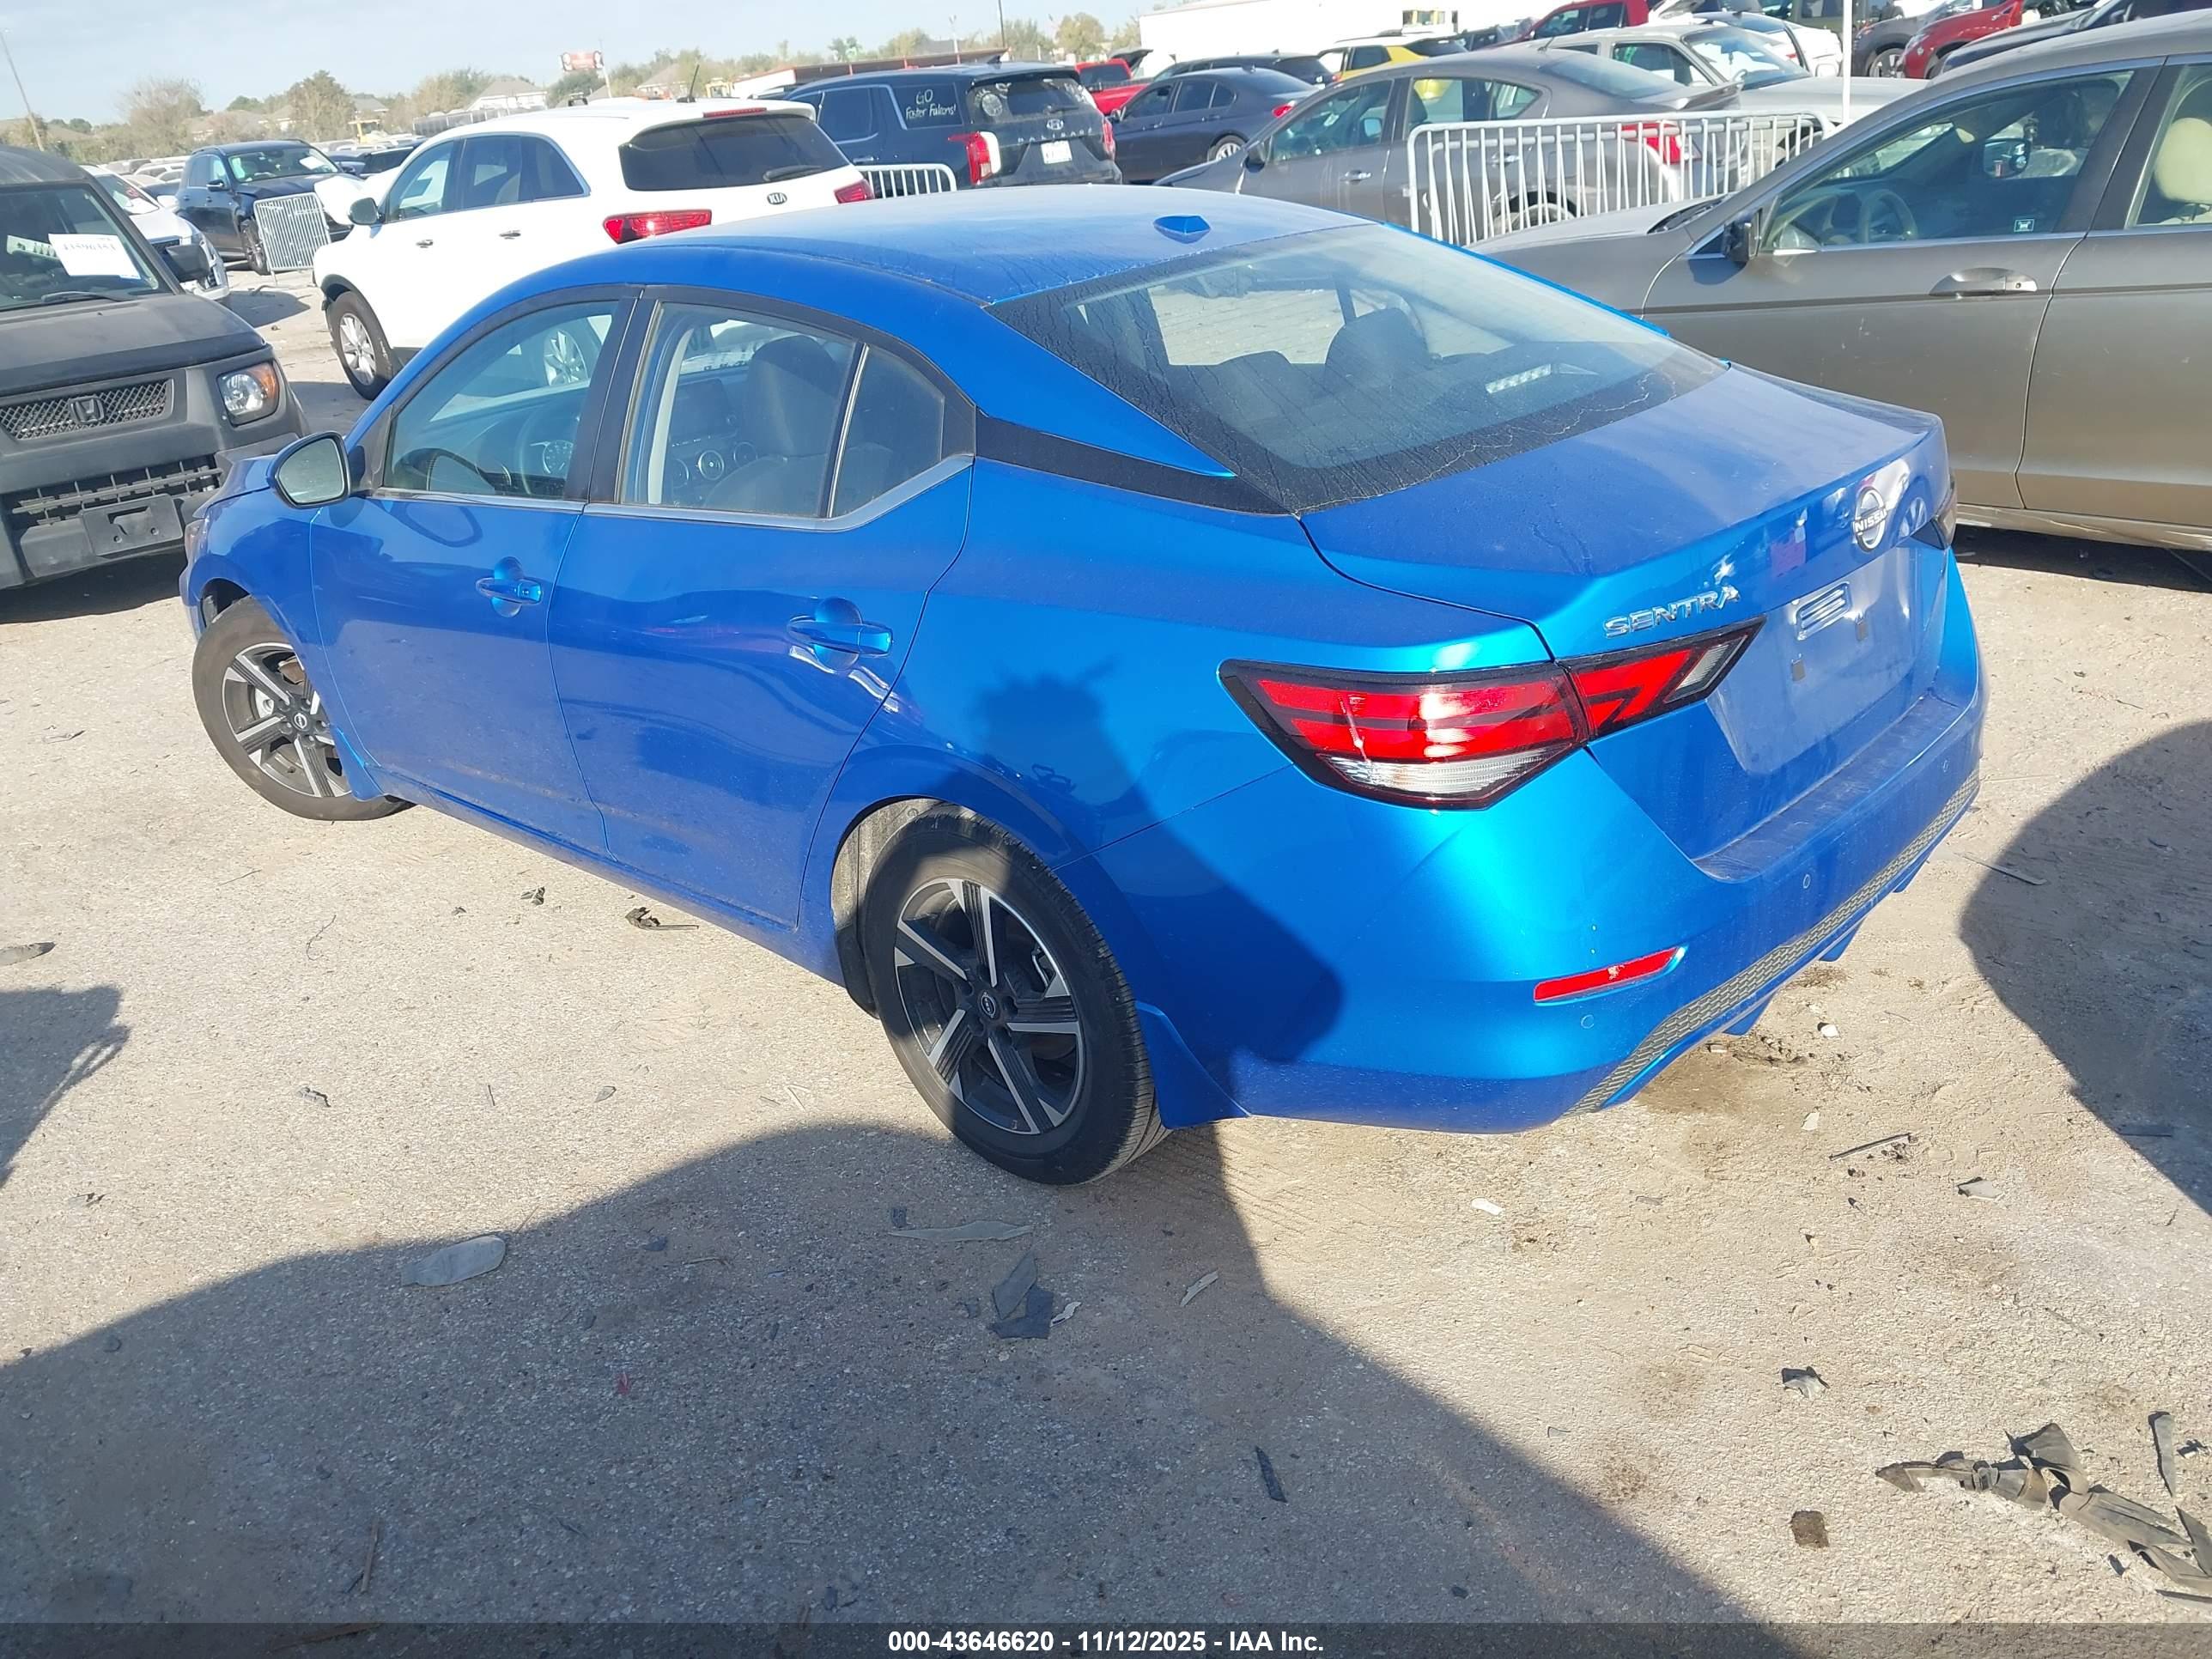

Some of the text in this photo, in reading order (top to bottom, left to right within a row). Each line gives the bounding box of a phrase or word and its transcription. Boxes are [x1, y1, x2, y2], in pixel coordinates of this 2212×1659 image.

[769, 193, 787, 204] KIA
[1855, 507, 1887, 532] NISSAN
[1603, 582, 1741, 640] SENTRA
